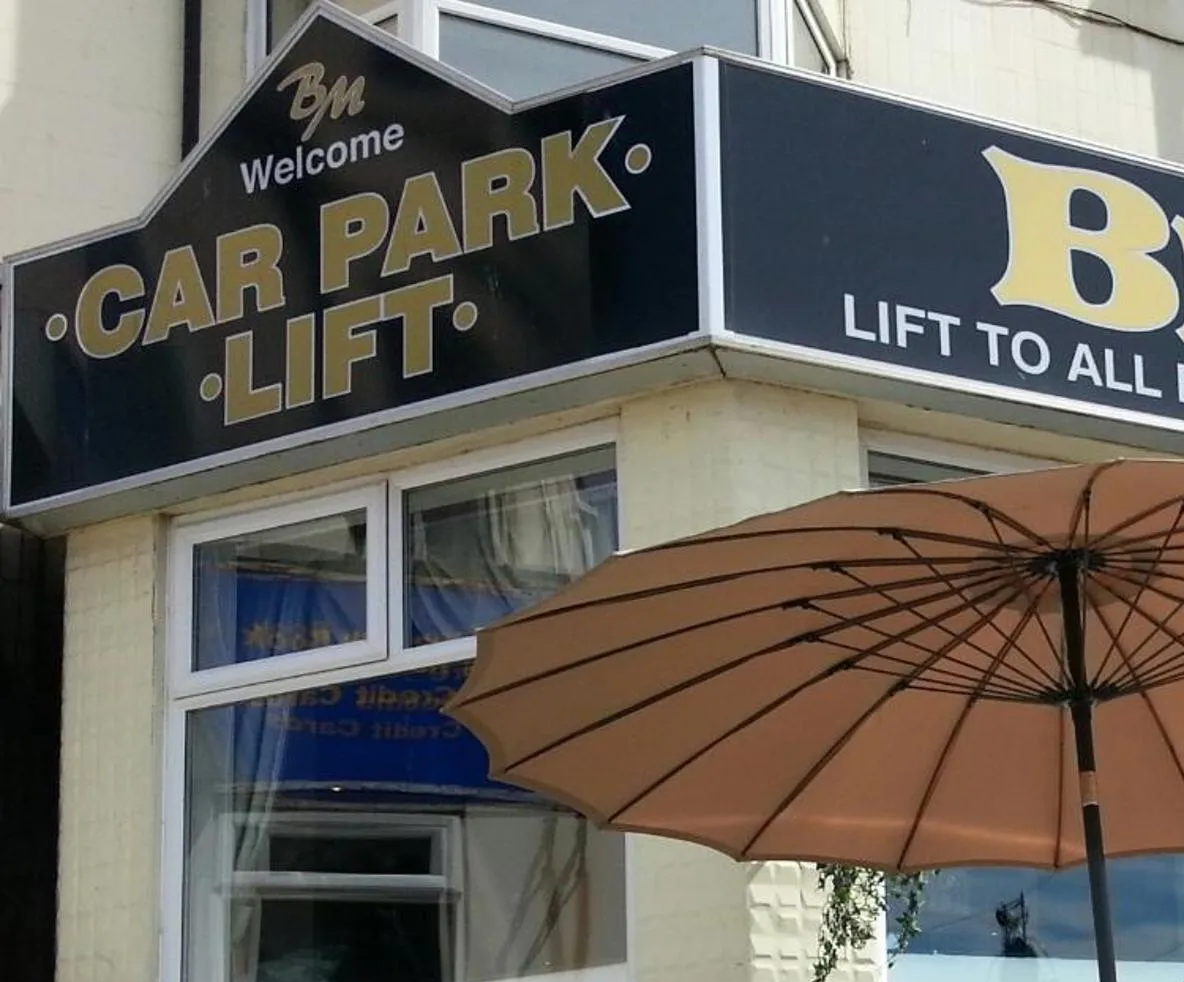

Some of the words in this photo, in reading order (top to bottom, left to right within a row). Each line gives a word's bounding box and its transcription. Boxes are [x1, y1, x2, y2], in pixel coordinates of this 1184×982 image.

[240, 123, 405, 194] Welcome
[75, 223, 286, 360] CAR
[320, 115, 631, 294] PARK
[224, 275, 453, 426] LIFT
[843, 293, 960, 357] LIFT
[976, 321, 1050, 375] TO
[1068, 344, 1163, 398] ALL
